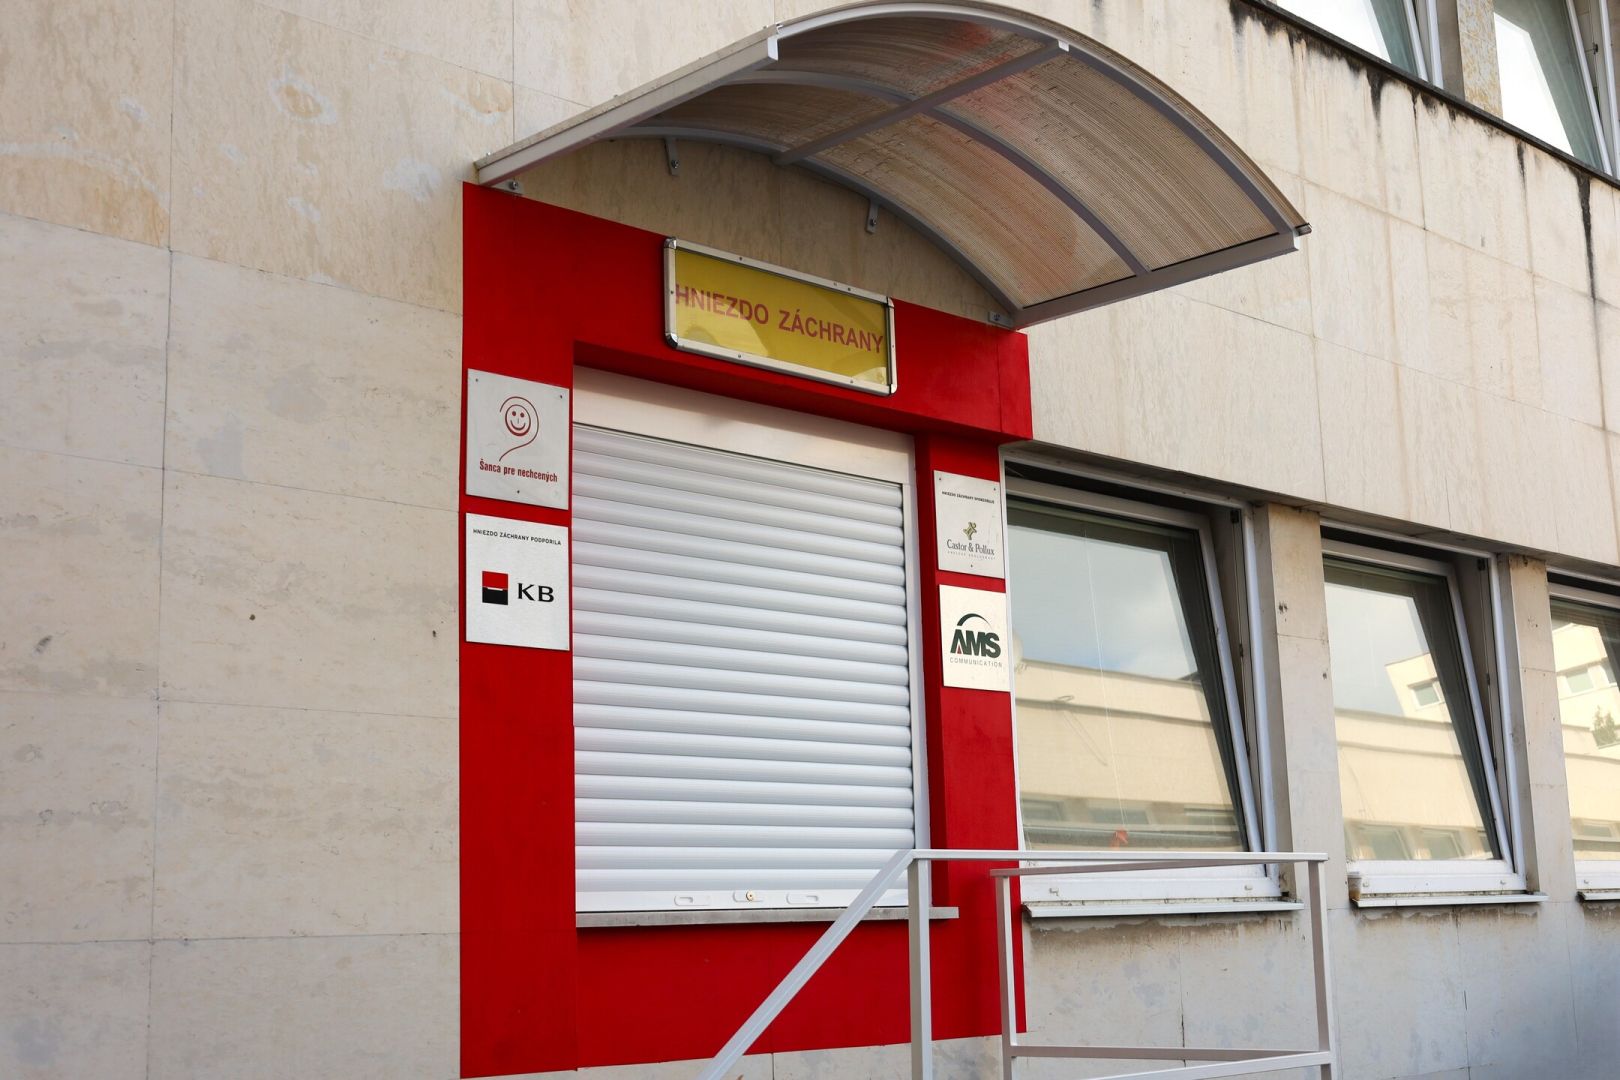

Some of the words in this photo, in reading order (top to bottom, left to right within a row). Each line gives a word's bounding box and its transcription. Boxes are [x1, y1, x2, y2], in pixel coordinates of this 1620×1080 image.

[675, 284, 769, 325] HNIEZDO
[778, 309, 884, 354] ZÁCHRANY
[479, 458, 501, 473] Šanca
[503, 466, 516, 475] pre
[517, 468, 558, 483] nechcených
[472, 528, 498, 537] HNIEZDO
[499, 532, 529, 541] ZÁCHRANY
[530, 536, 562, 545] PODPORILA
[946, 539, 967, 551] Castor
[968, 542, 974, 552] &
[975, 543, 995, 556] Pollux
[517, 583, 555, 603] KB
[950, 629, 1001, 659] AMS
[950, 657, 1003, 668] COMMUNICATION
